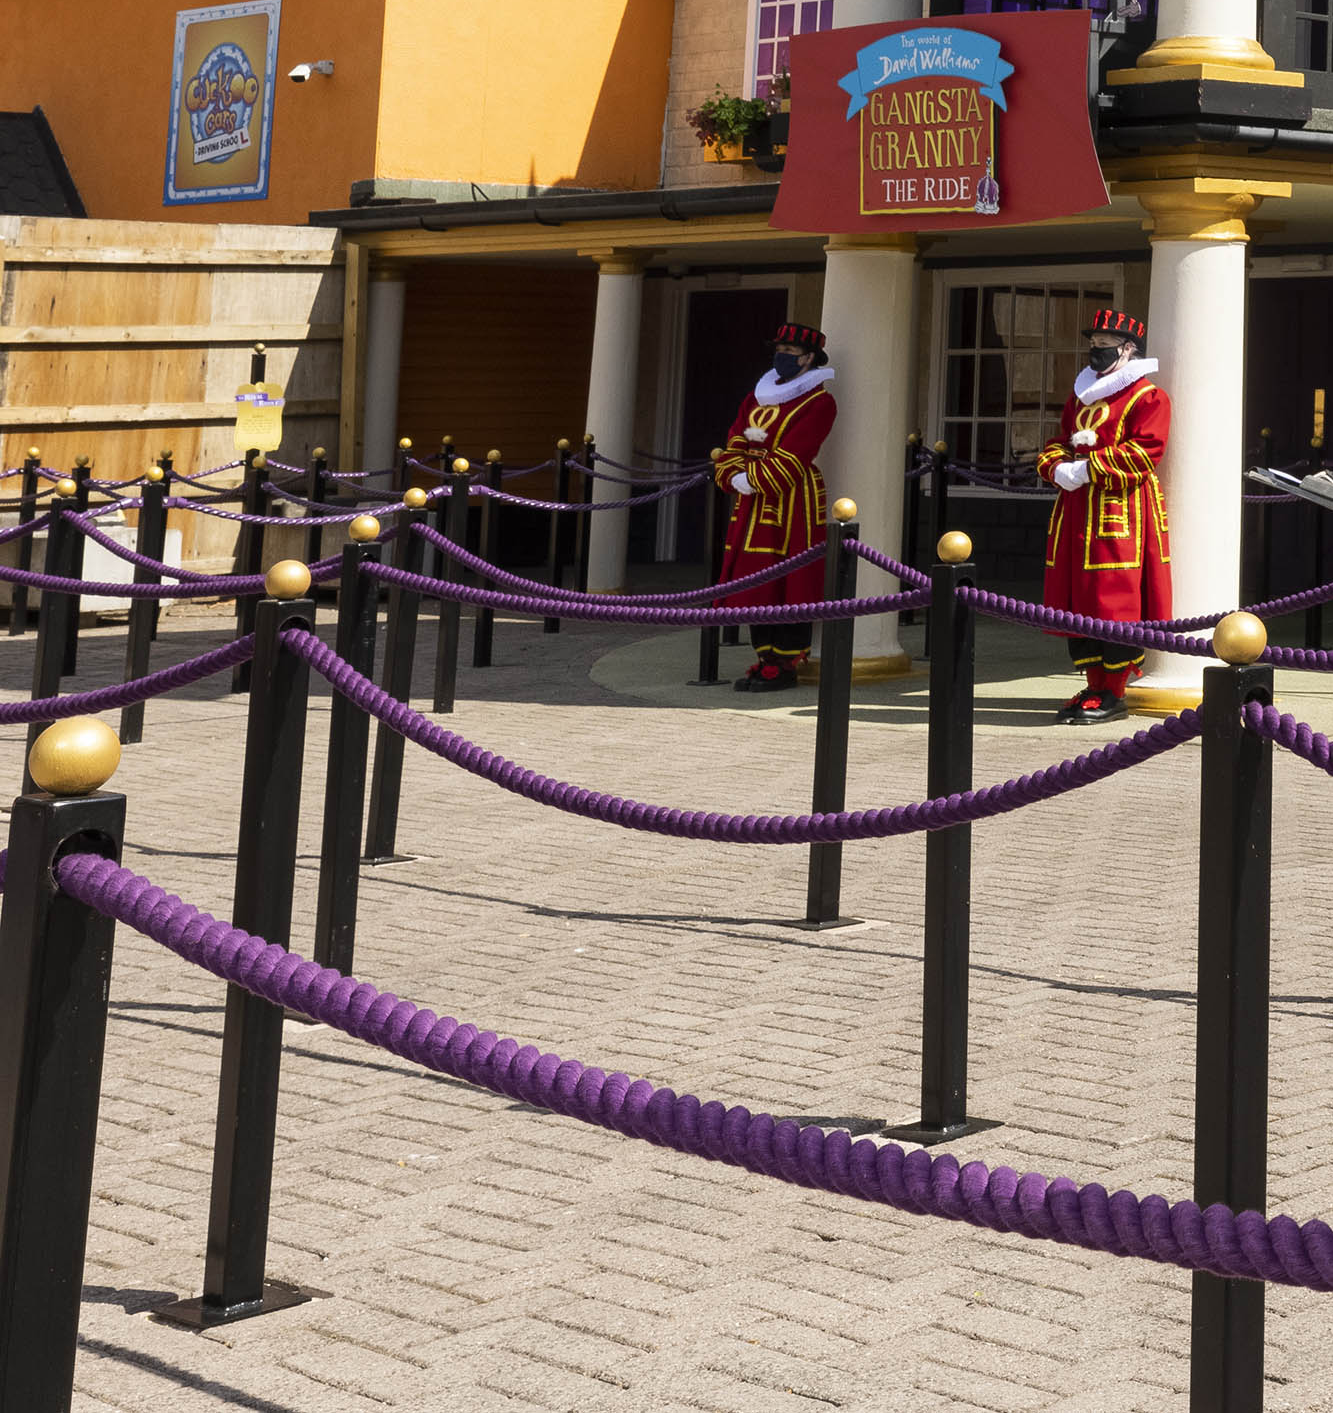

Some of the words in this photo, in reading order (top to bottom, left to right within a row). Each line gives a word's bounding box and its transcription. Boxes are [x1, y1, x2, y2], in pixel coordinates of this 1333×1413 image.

[900, 34, 915, 48] The
[917, 34, 941, 46] world
[943, 34, 953, 45] of
[873, 47, 918, 85] David
[919, 47, 981, 71] Walliams
[870, 87, 984, 126] GANGSTA
[869, 126, 983, 172] GRANNY
[882, 178, 919, 203] THE
[924, 177, 971, 202] RIDE
